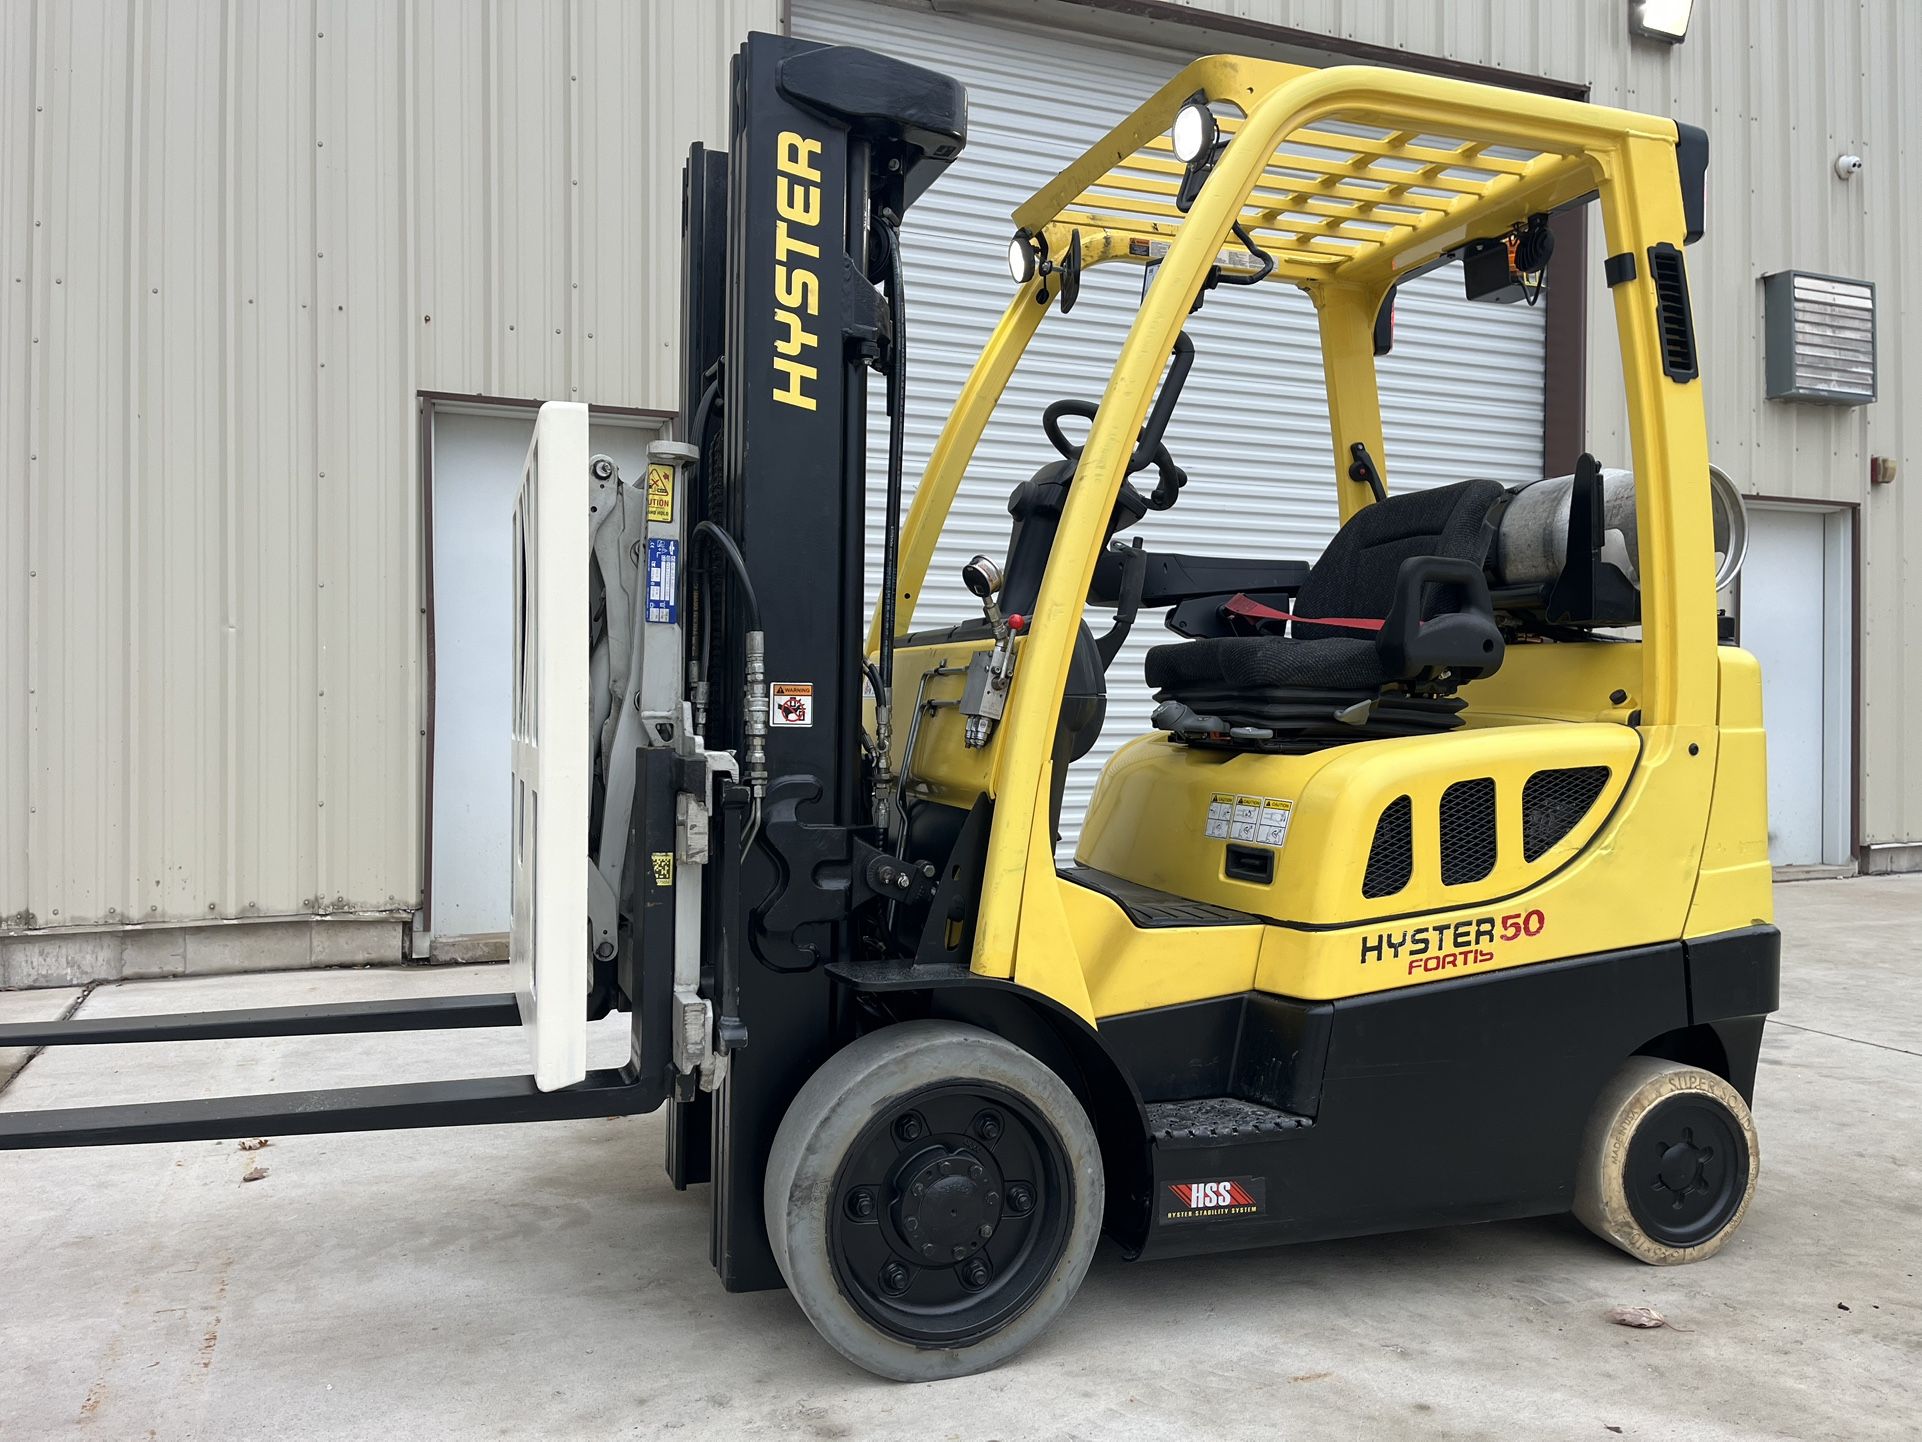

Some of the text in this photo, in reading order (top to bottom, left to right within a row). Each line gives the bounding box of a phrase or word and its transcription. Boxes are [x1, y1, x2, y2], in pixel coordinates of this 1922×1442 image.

[772, 130, 822, 411] HYSTER
[648, 498, 669, 507] UTION
[1360, 909, 1545, 964] HYSTER 50
[1668, 1075, 1717, 1094] SUPER
[1612, 1137, 1622, 1165] MADE
[1624, 1111, 1638, 1127] USA
[1190, 1181, 1231, 1209] HSS
[1167, 1206, 1257, 1219] HYSTER STABILITY SYSTEM
